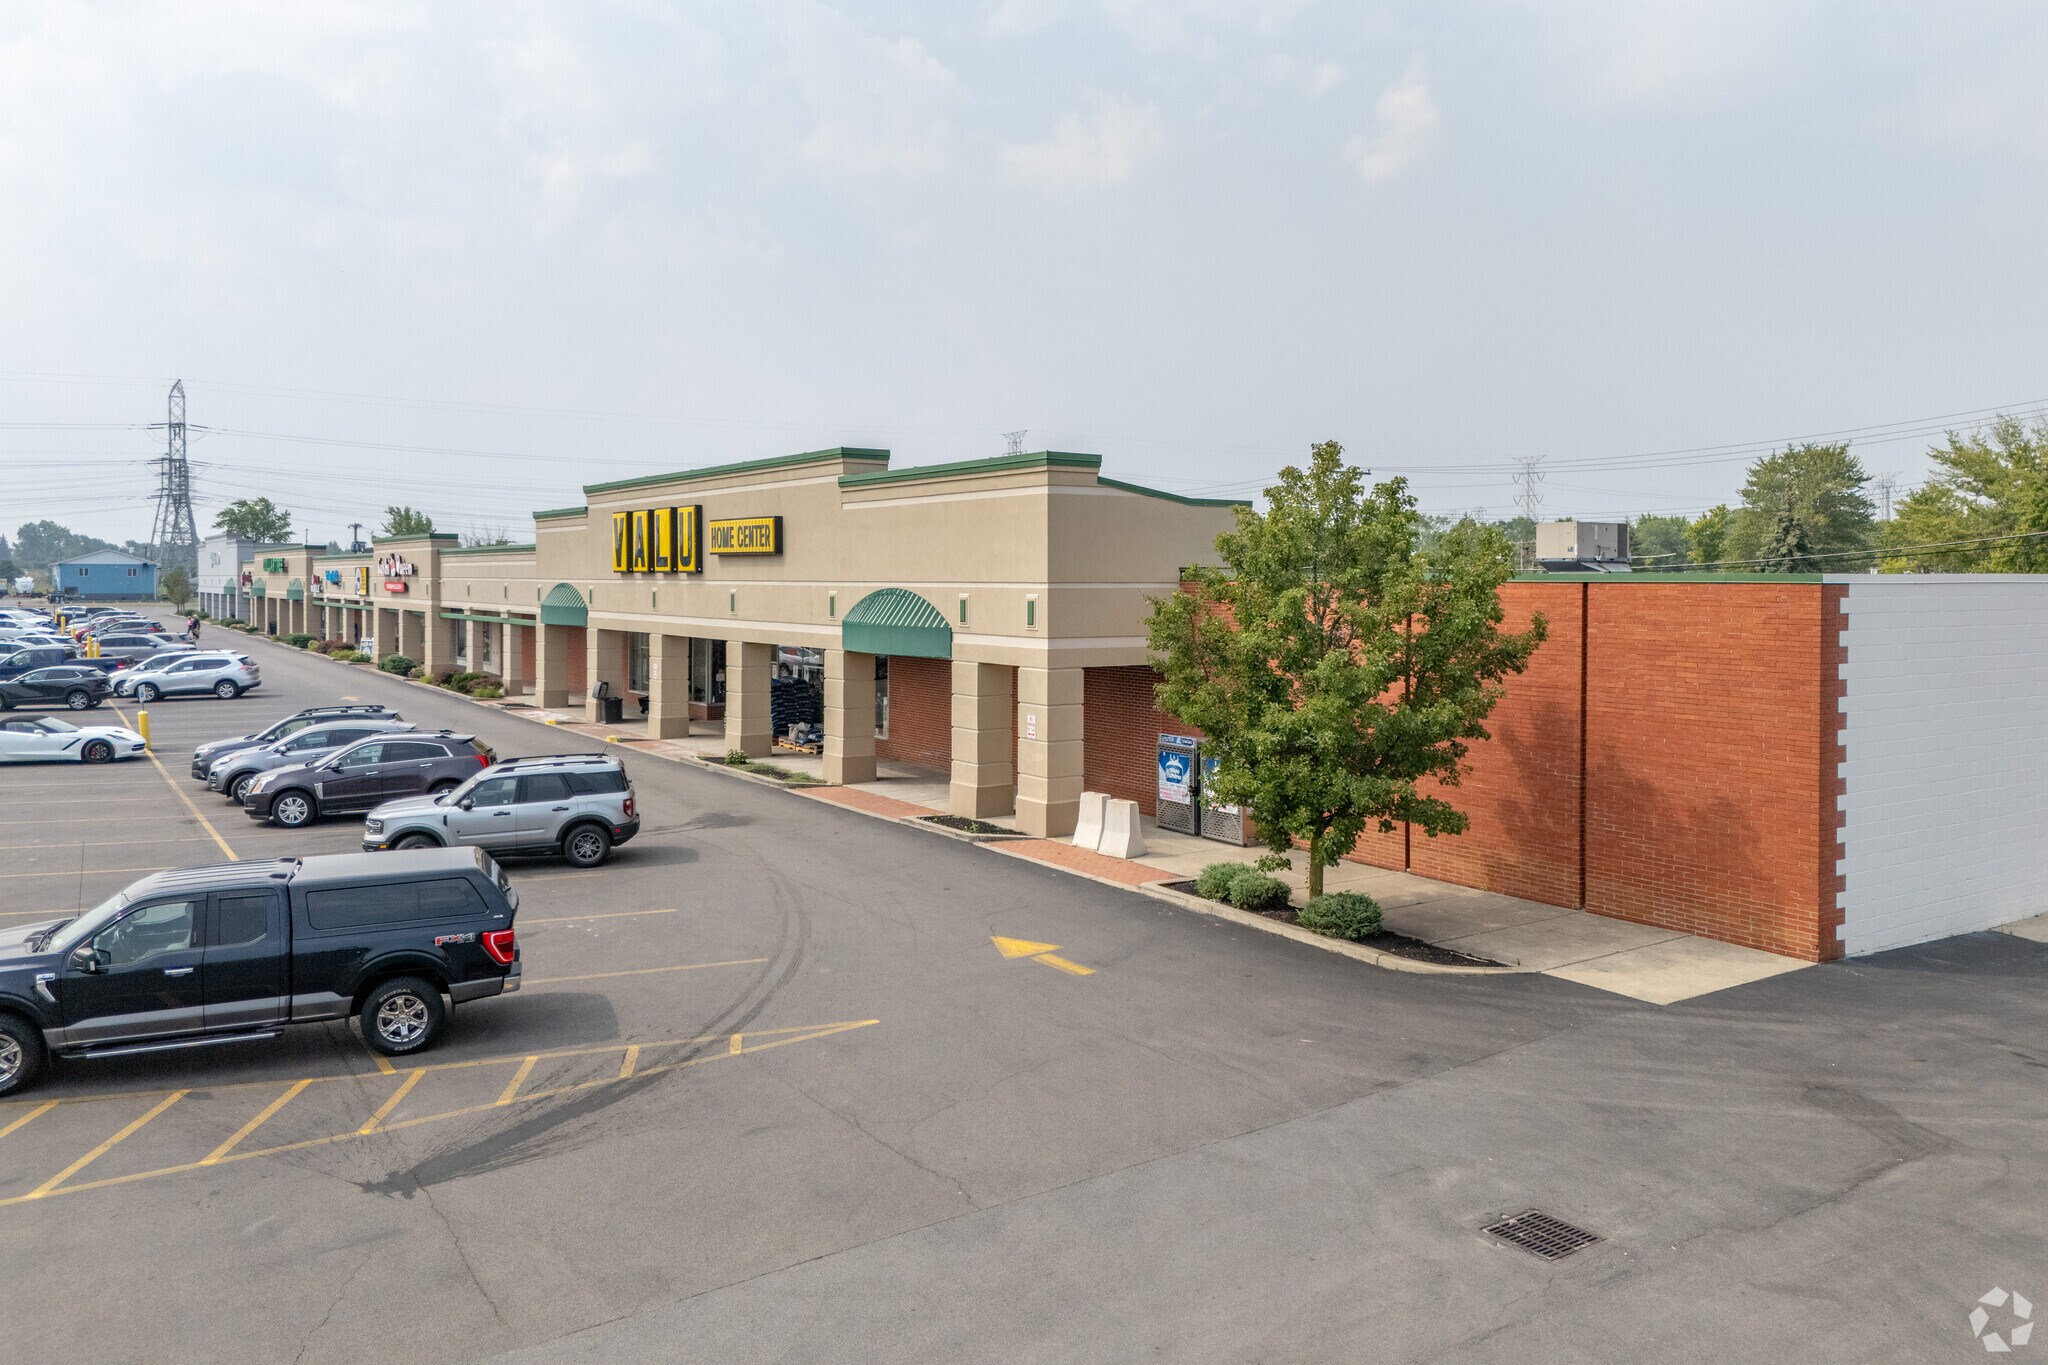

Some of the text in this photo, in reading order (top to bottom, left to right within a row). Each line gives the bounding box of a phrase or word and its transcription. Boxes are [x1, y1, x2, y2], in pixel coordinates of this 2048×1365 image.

[613, 511, 693, 568] VALU
[711, 524, 771, 549] HOME CENTER
[435, 932, 475, 946] FX4
